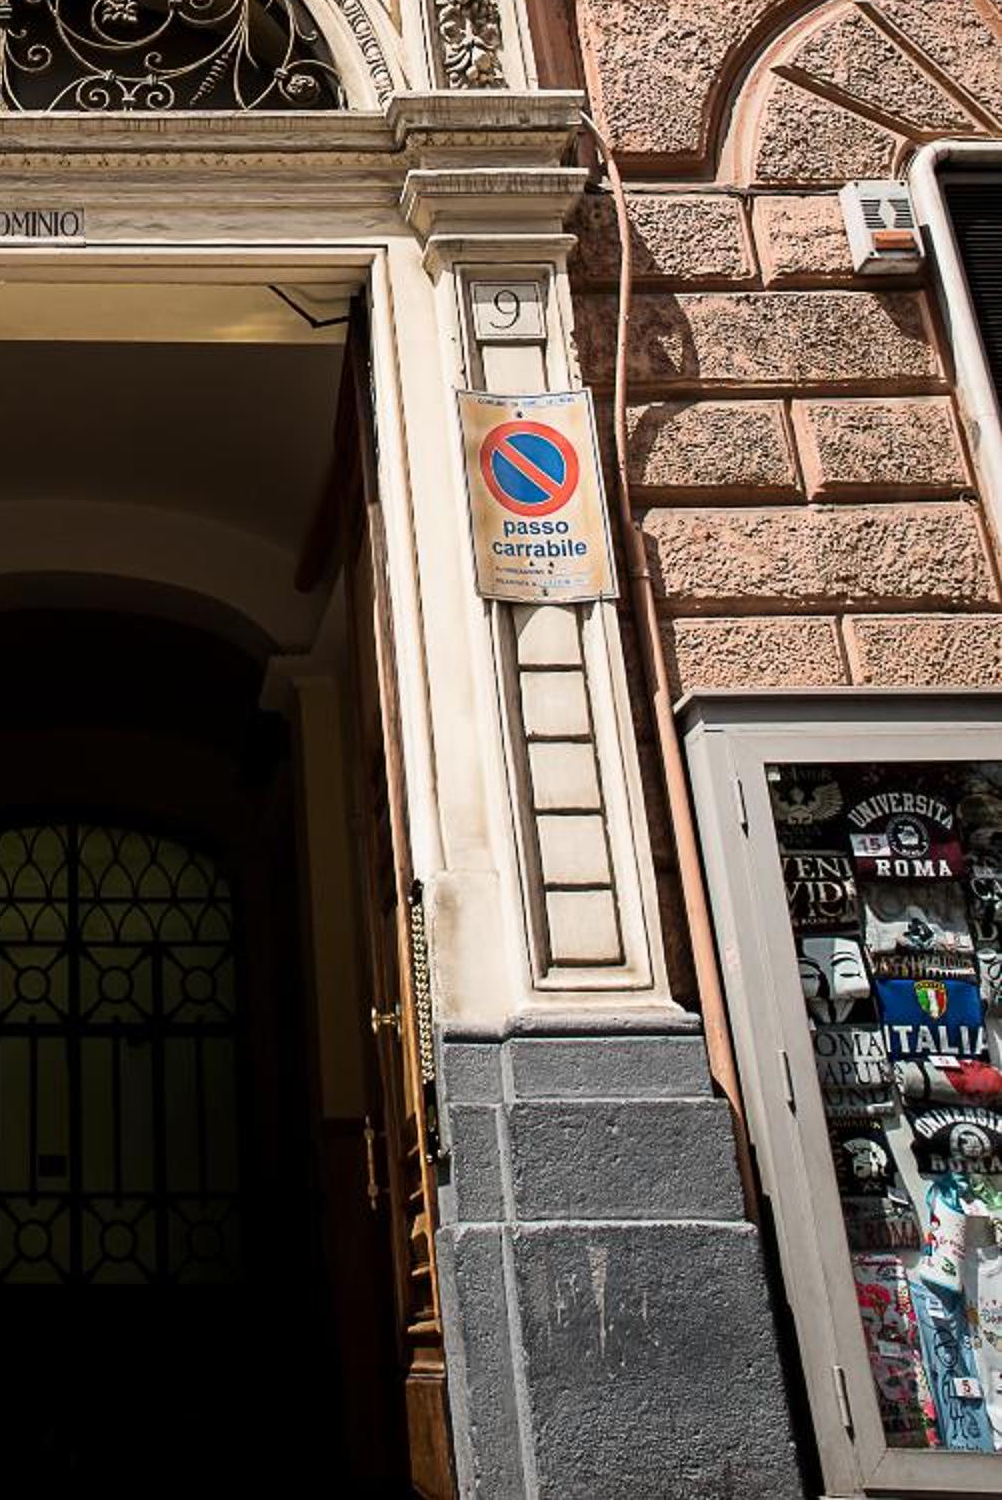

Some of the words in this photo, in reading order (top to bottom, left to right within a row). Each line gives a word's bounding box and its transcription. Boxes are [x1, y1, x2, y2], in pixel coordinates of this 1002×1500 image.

[489, 289, 520, 329] 9
[503, 520, 569, 537] passo
[492, 540, 587, 557] carrabile
[875, 860, 953, 877] ROMA
[816, 1033, 884, 1056] OMA
[883, 1025, 988, 1055] ITALIA
[962, 1380, 971, 1393] 5
